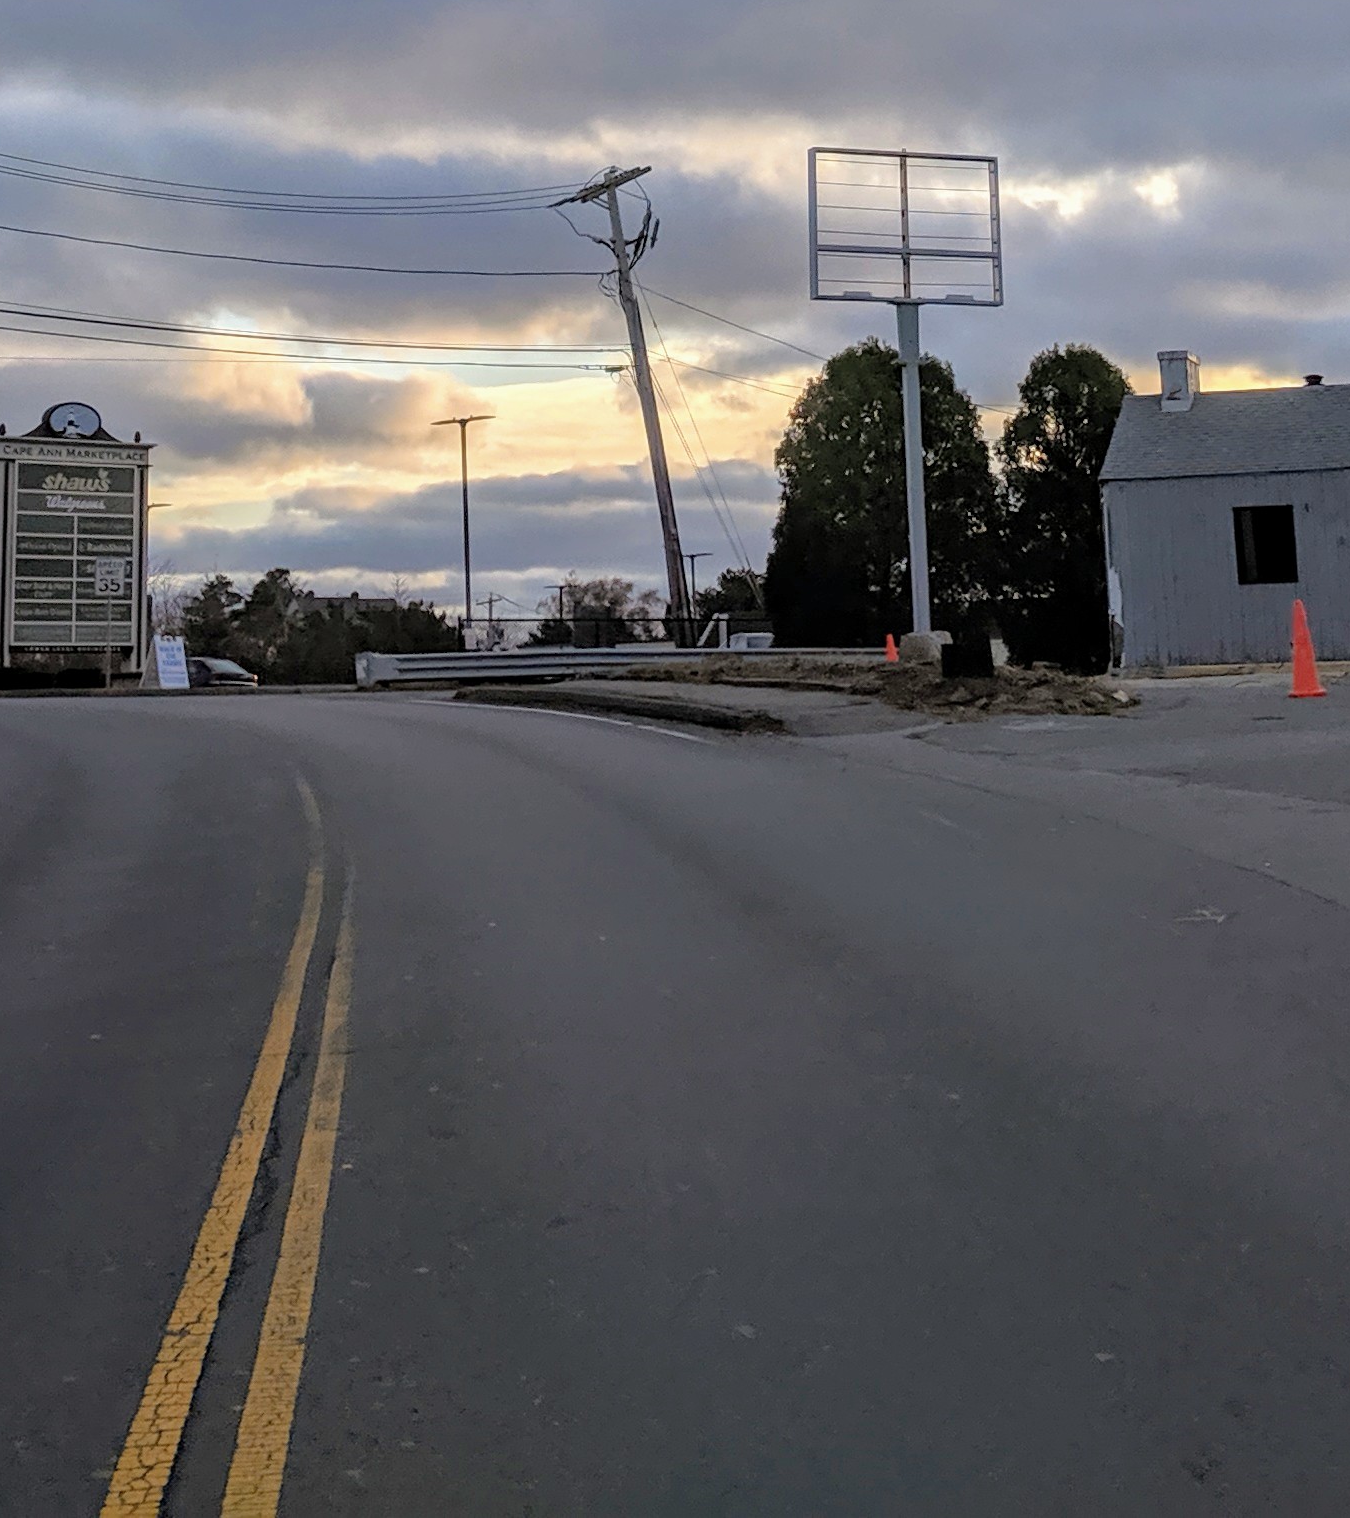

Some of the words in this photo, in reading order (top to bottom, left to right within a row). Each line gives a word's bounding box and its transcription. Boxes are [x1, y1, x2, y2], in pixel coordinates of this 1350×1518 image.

[3, 444, 33, 456] CAPE
[38, 446, 62, 457] ANN
[66, 447, 146, 461] MARKETPLACE
[46, 495, 106, 512] Walgreens
[98, 561, 123, 569] SPEED
[99, 578, 121, 593] 35
